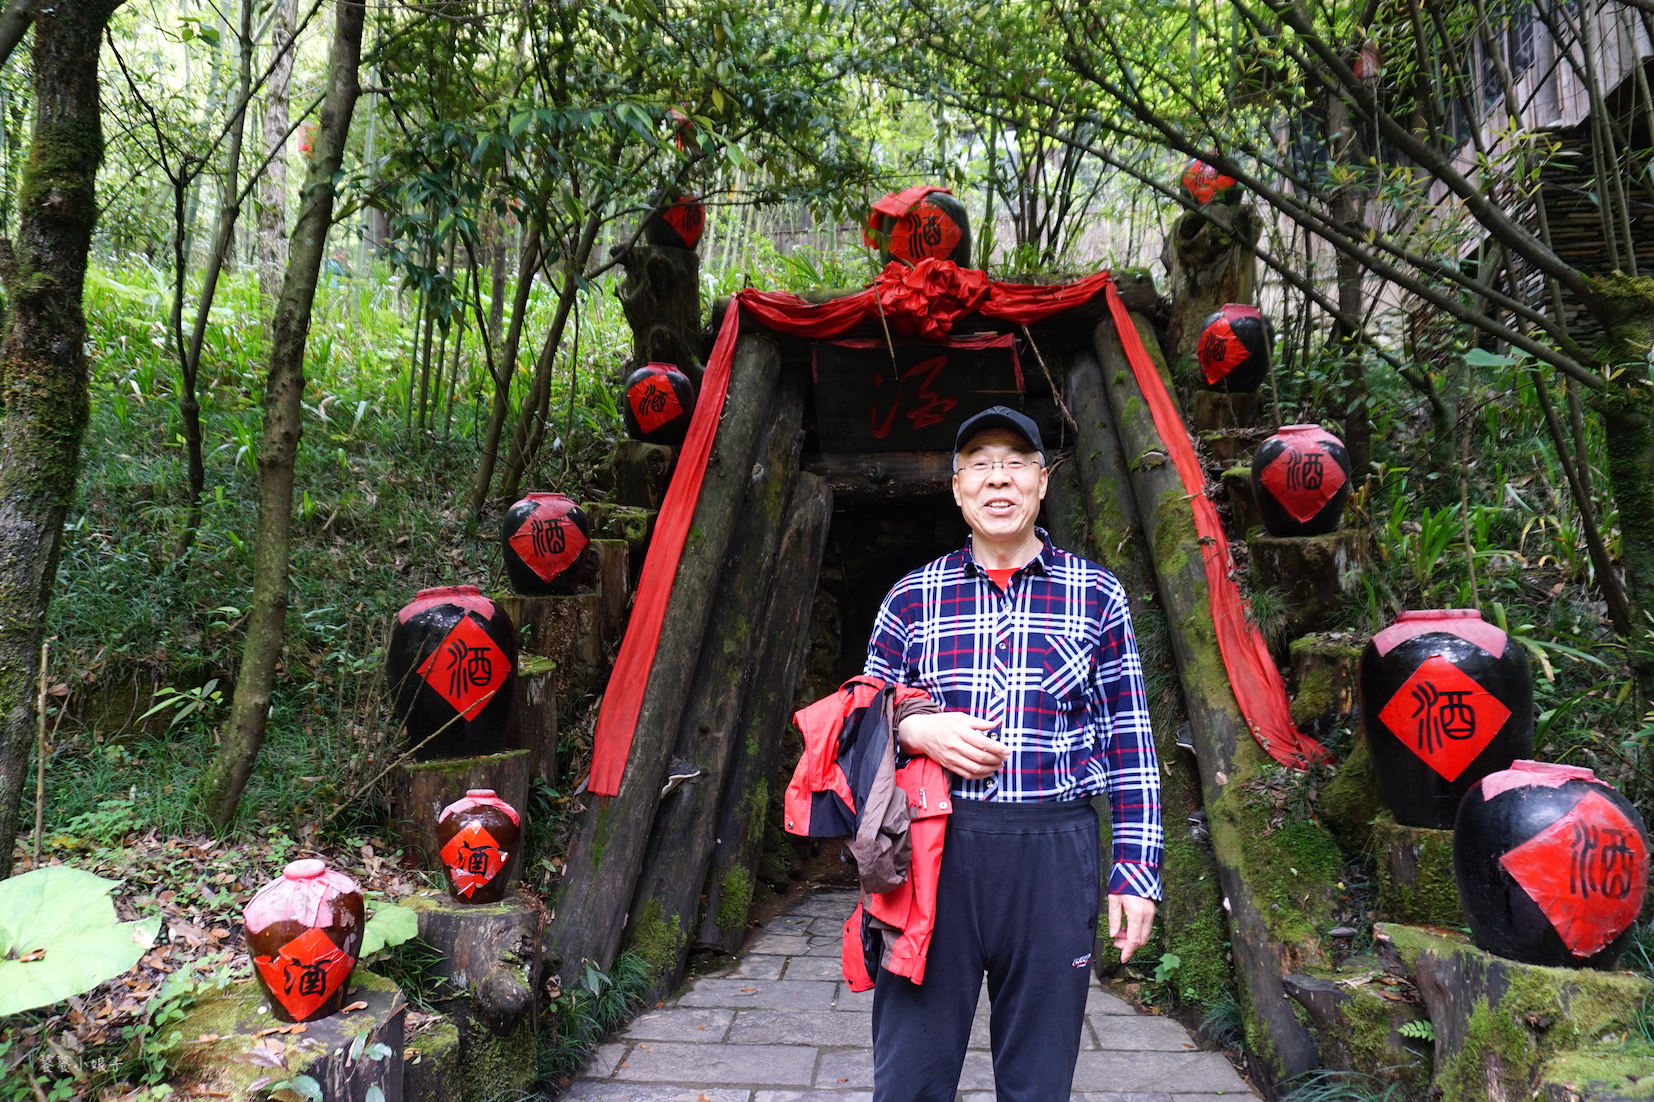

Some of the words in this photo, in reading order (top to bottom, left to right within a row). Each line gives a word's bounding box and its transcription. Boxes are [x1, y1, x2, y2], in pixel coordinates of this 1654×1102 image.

[905, 212, 942, 259] 酒
[1203, 331, 1228, 367] 酒
[638, 383, 669, 416] 酒
[1286, 449, 1324, 492] 酒
[530, 518, 566, 558] 酒
[446, 638, 492, 699] 酒
[1411, 680, 1476, 755] 酒
[457, 840, 493, 878] 酒
[1569, 818, 1634, 900] 酒
[283, 957, 333, 997] 酒
